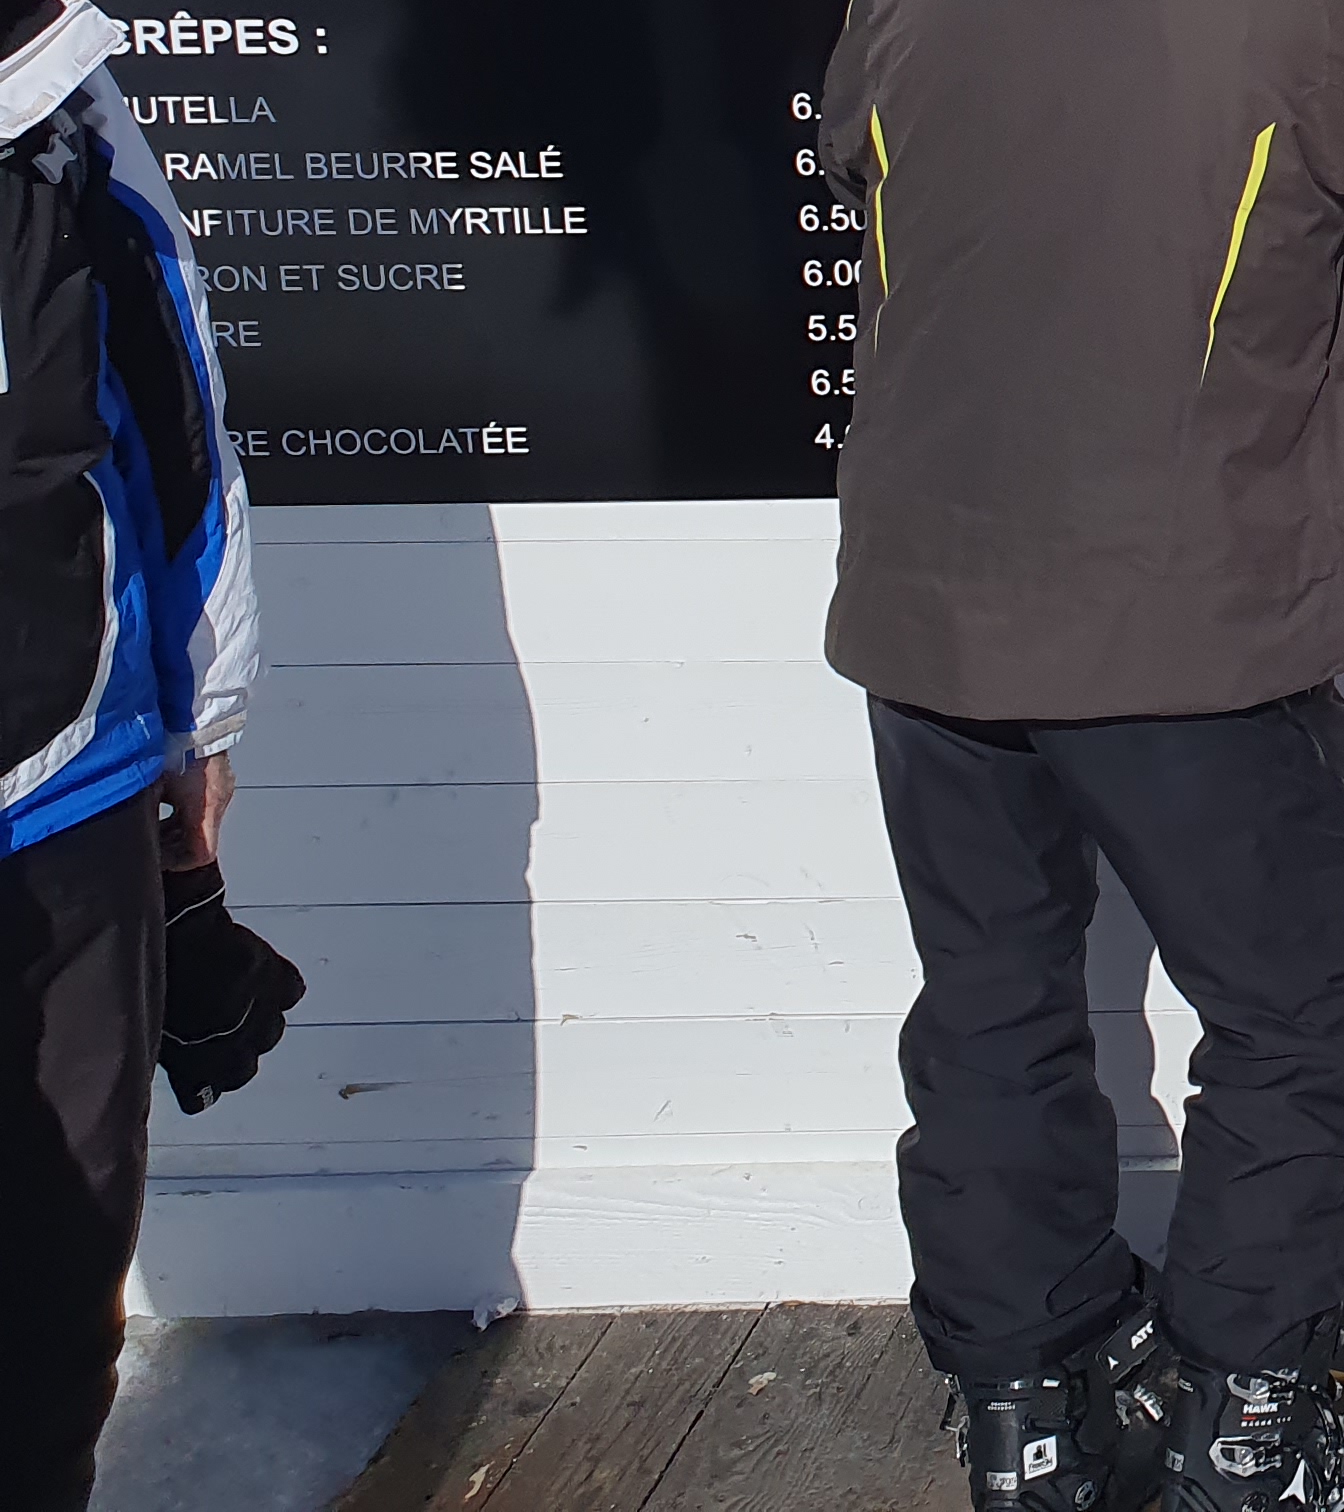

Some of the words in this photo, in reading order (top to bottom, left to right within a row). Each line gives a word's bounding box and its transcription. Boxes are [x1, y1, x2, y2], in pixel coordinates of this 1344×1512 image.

[122, 92, 277, 125] UTELLA
[166, 150, 295, 181] RAMEL
[305, 151, 460, 180] BEURRE
[469, 144, 564, 179] SALÉ
[180, 207, 338, 239] NFITURE
[348, 208, 399, 235] DE
[409, 206, 588, 235] MYRTILLE
[279, 264, 325, 291] ET
[337, 263, 466, 291] SUCRE
[807, 314, 857, 342] 5.5
[810, 368, 856, 396] 6.5
[281, 421, 530, 456] CHOCOLATÉE
[1242, 1403, 1279, 1415] HAWX
